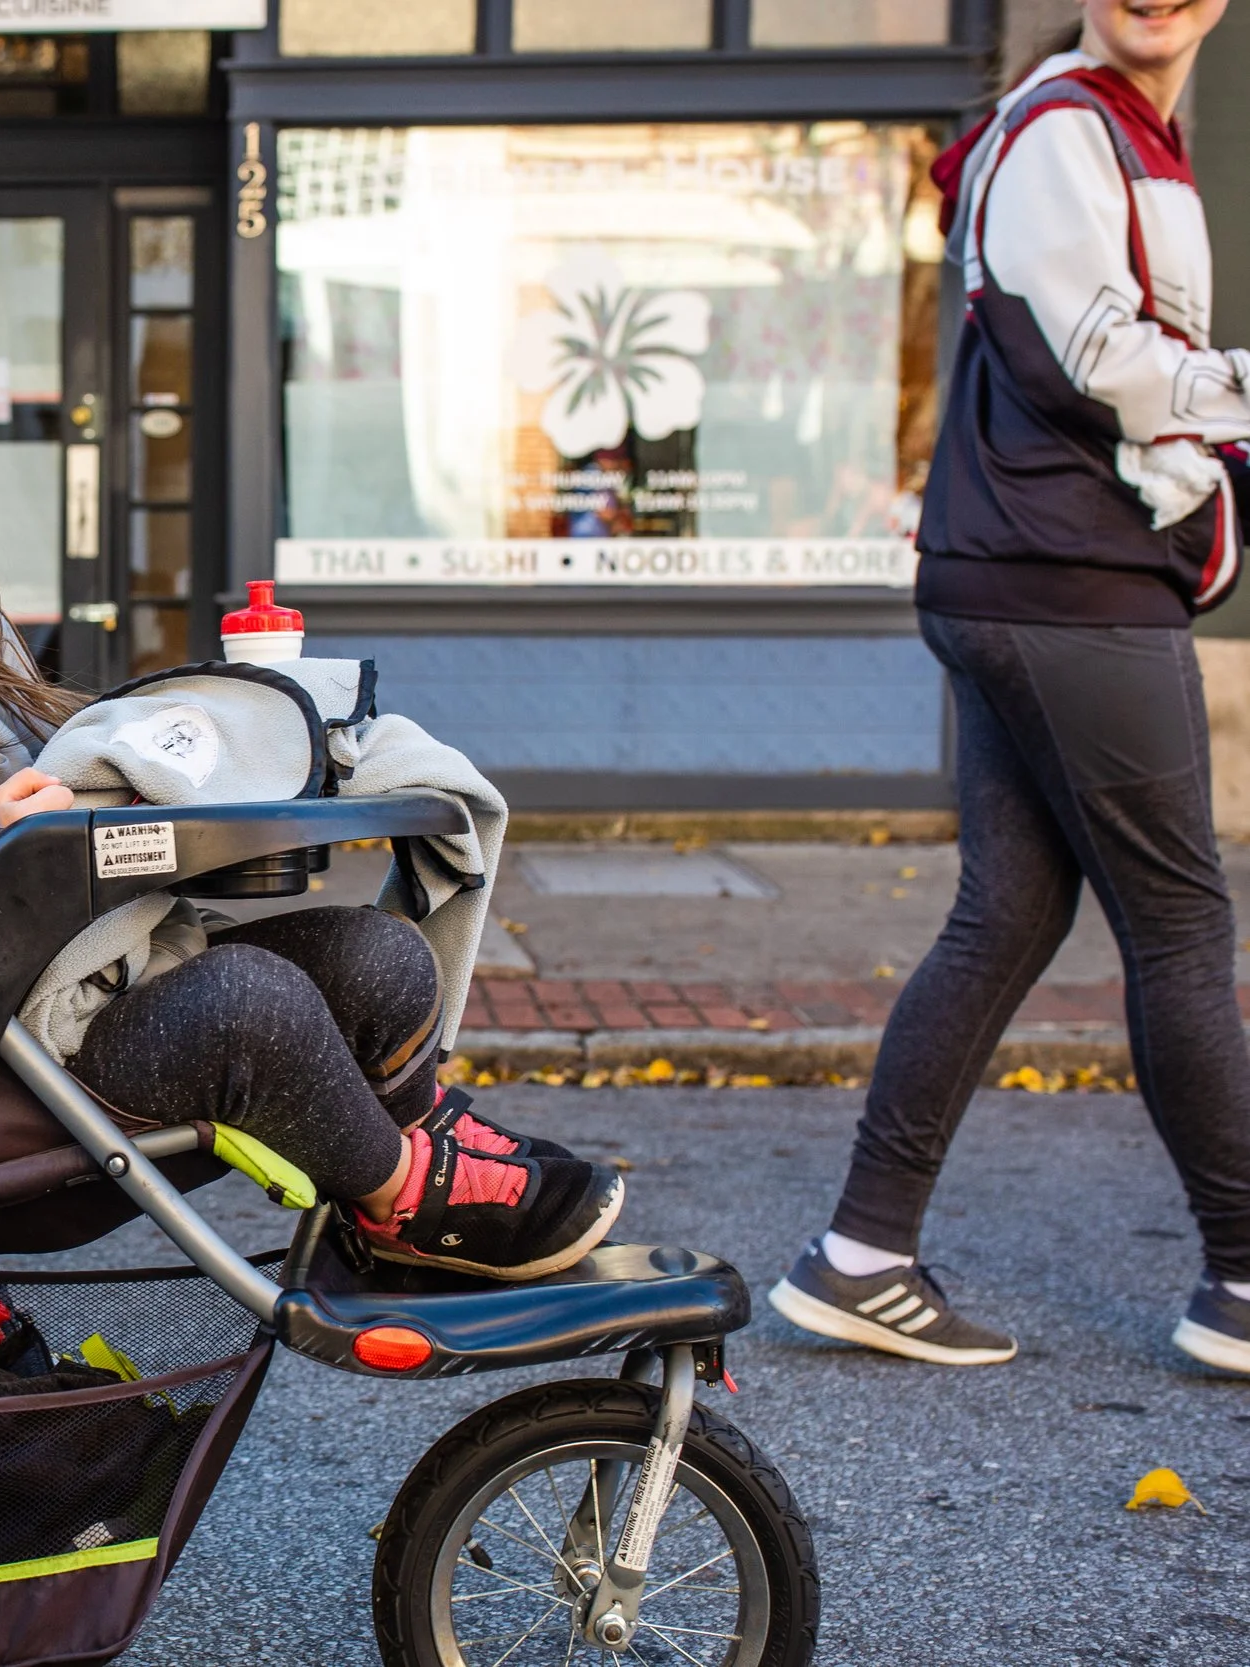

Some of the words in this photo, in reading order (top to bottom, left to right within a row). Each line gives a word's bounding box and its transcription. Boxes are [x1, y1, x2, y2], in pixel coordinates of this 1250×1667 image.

[236, 121, 267, 238] 125
[309, 547, 386, 575] THAI
[440, 547, 539, 576] SUSHI
[595, 546, 751, 575] NOODLES
[765, 547, 789, 574] &
[801, 546, 904, 574] MORE
[644, 1443, 658, 1472] GARDE
[640, 1471, 649, 1484] EN
[634, 1484, 645, 1506] MISE
[620, 1510, 639, 1551] WARNING
